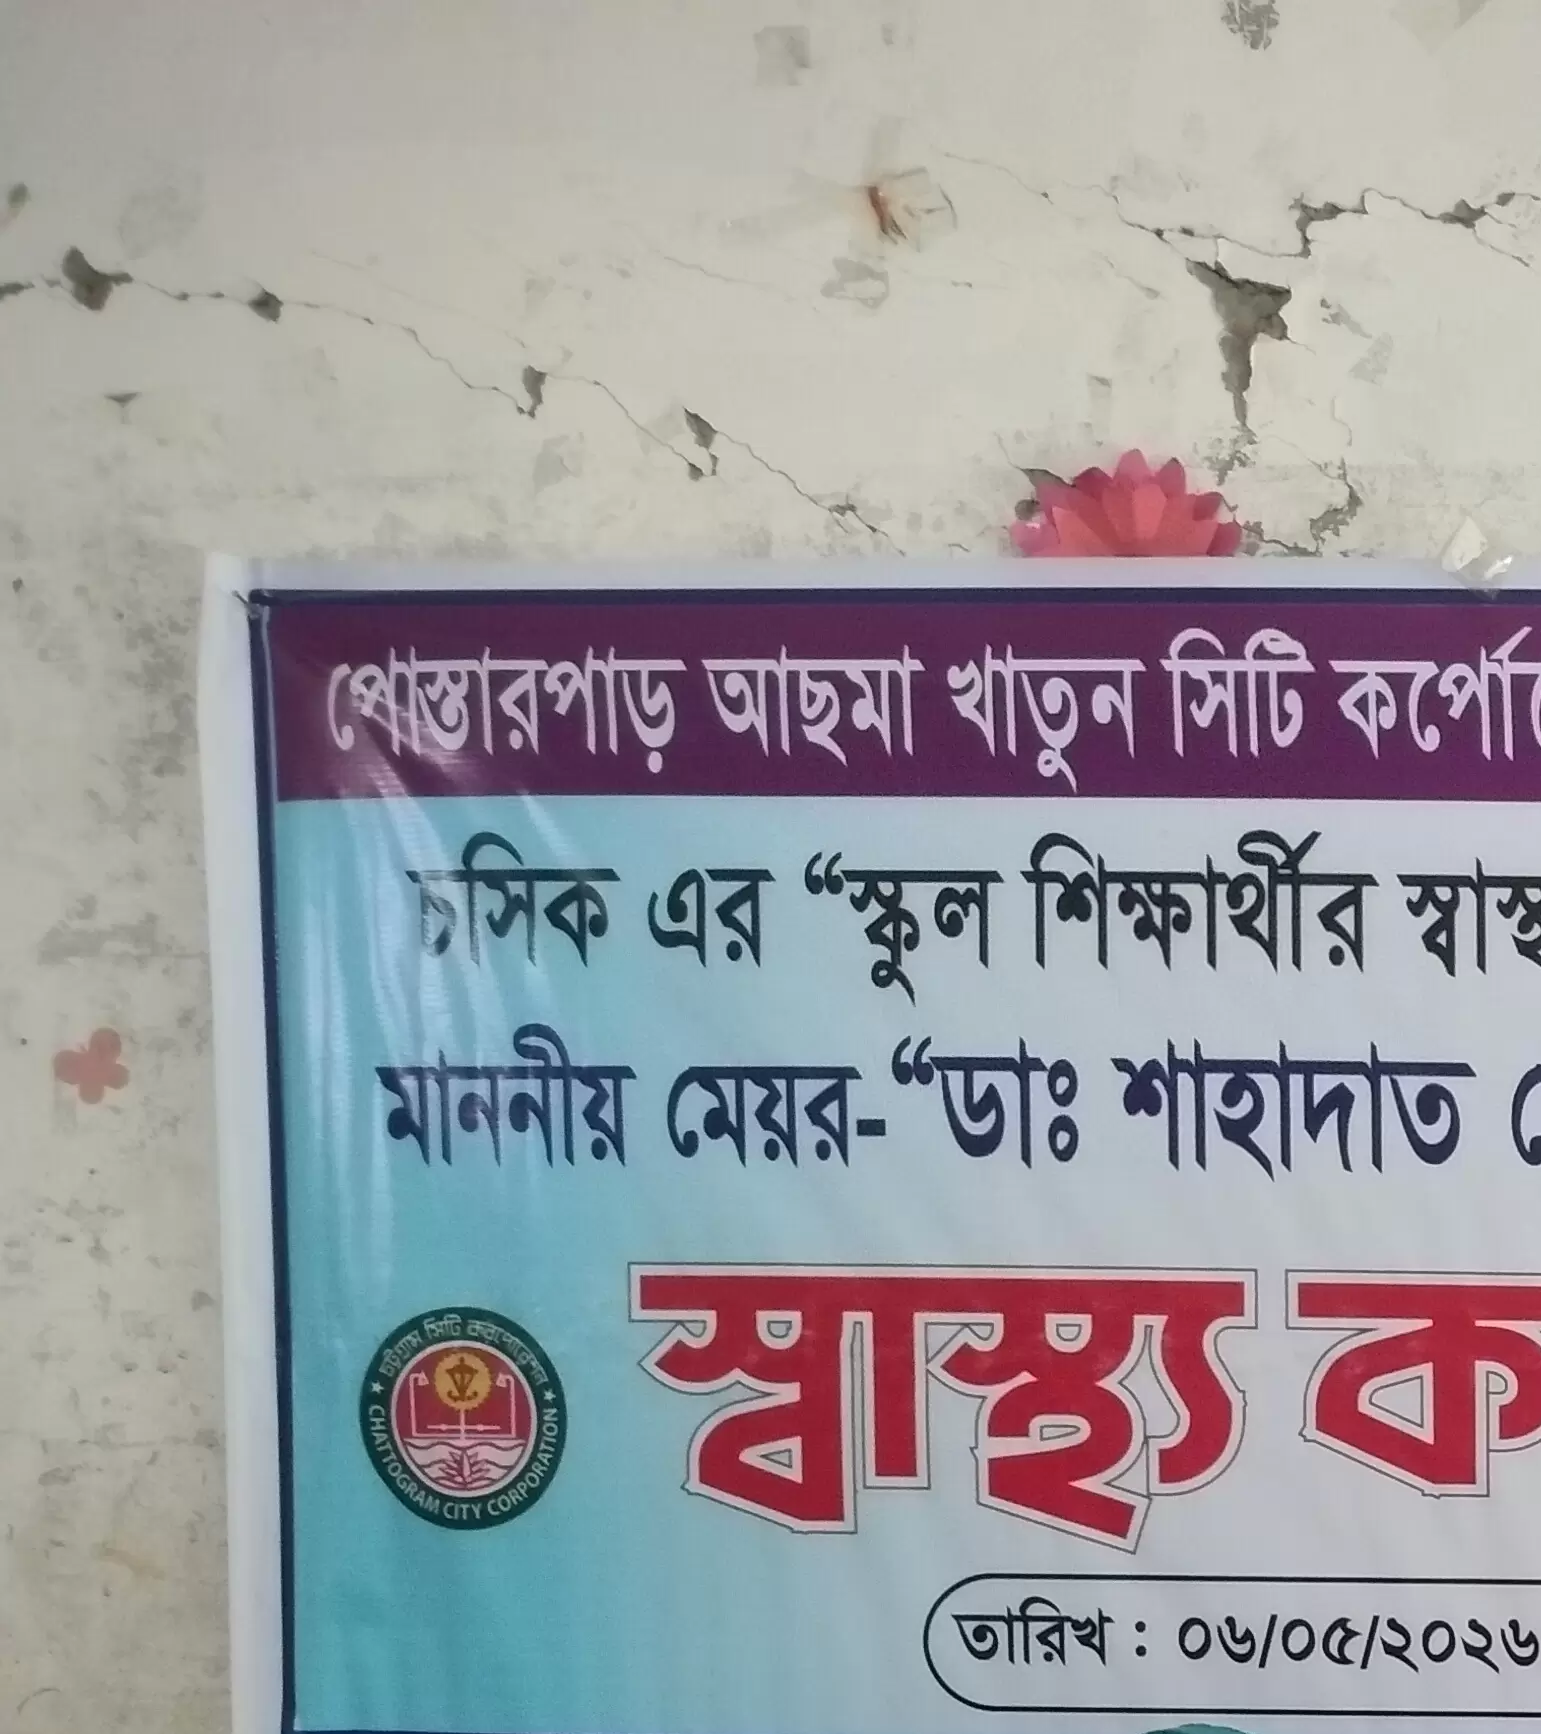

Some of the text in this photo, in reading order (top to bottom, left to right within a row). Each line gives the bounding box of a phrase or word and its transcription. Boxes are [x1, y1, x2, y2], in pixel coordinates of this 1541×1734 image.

[702, 645, 925, 765] আছমা
[947, 645, 1146, 792] খাতুন
[1160, 628, 1315, 757] সিটি
[406, 832, 620, 967] চসিক
[648, 869, 775, 967] এর
[1020, 830, 1379, 972] শিক্ষার্থীর
[375, 1023, 636, 1167] মাননীয়
[1111, 1039, 1476, 1181] শাহাদাত
[368, 1404, 559, 1520] CHATTOGRAM CITY CORPORATION
[630, 1265, 1256, 1551] স্বাস্থ্য
[952, 1597, 1114, 1665] তারিখ
[1179, 1615, 1539, 1673] ০৬/০৫/২০২৬
